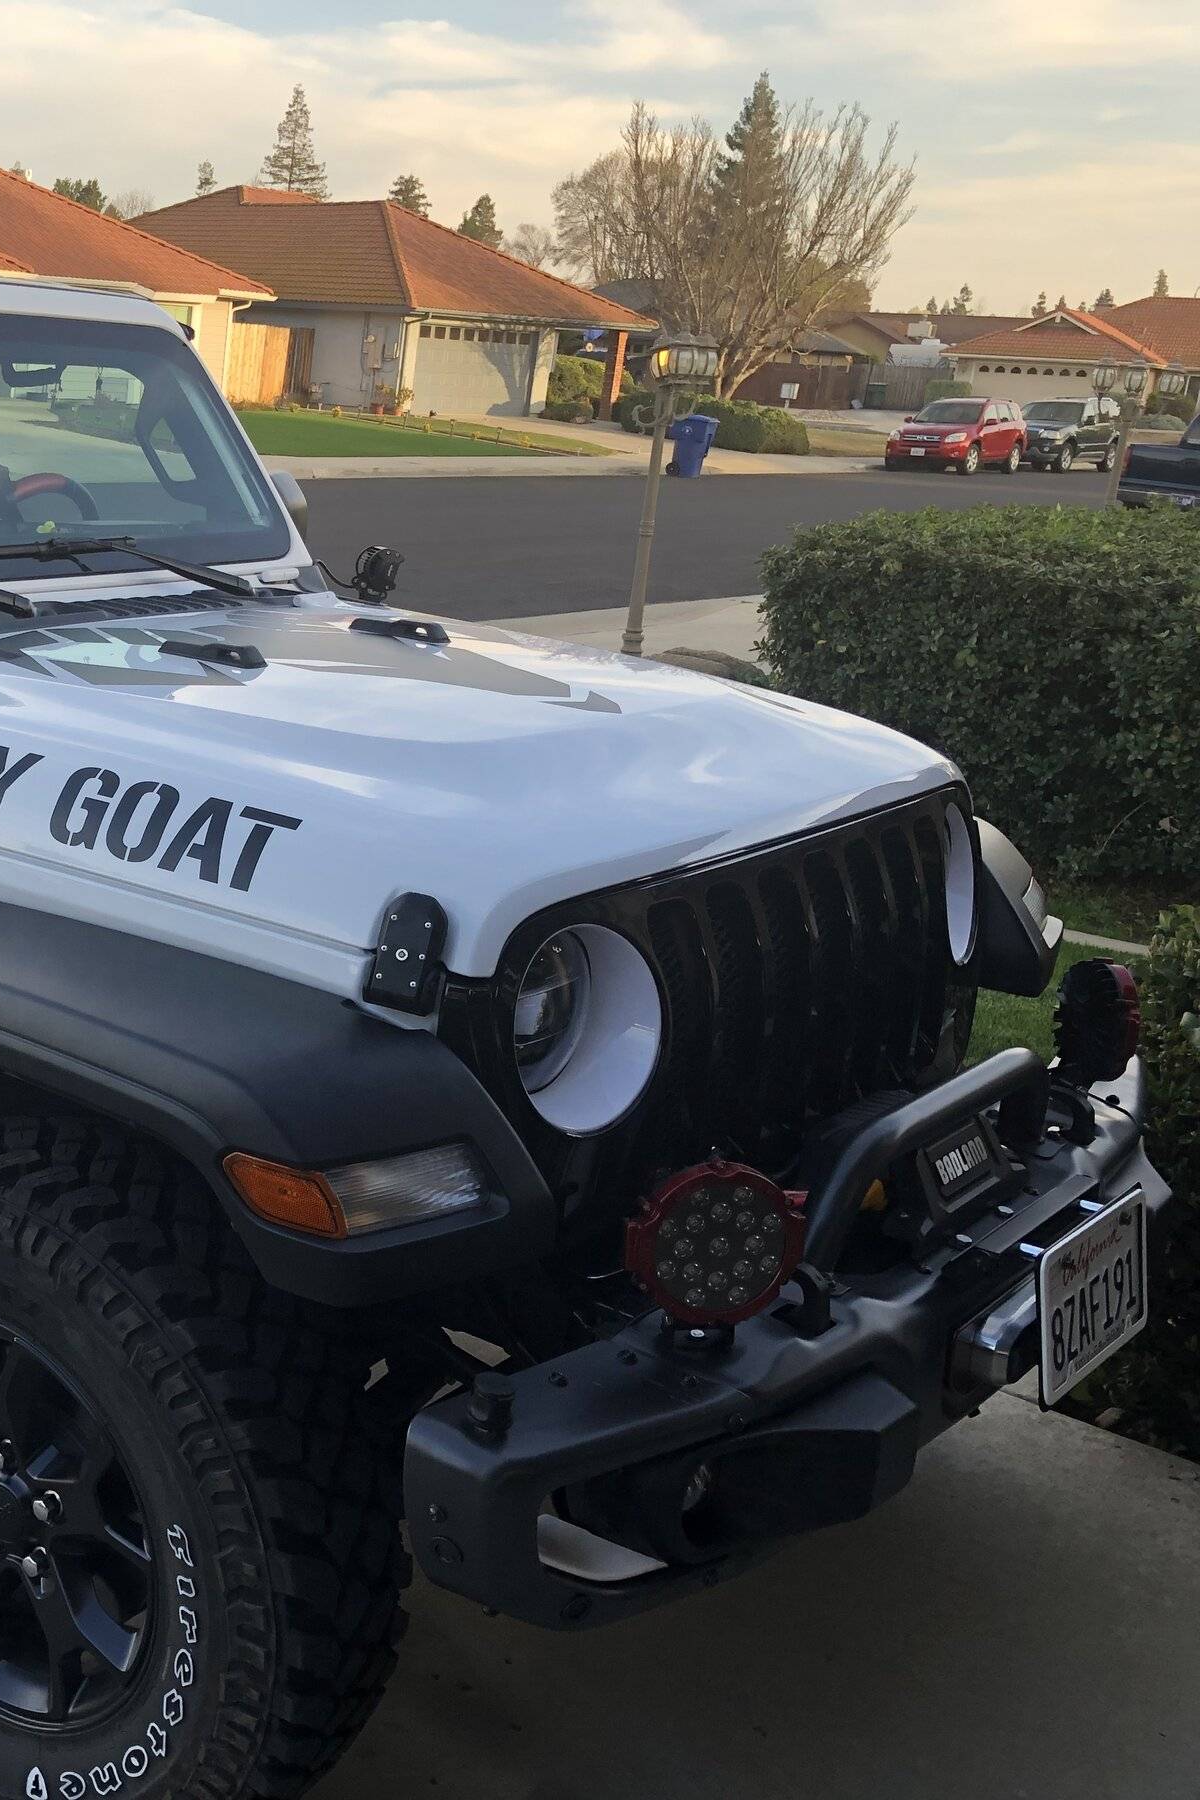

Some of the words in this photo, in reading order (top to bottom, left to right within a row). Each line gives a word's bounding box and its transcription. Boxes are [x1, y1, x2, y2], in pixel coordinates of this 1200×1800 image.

[48, 766, 304, 893] GOAT
[935, 1136, 988, 1185] BADLAND
[1051, 1249, 1137, 1372] 8ZAF191
[58, 1524, 197, 1800] Firestone
